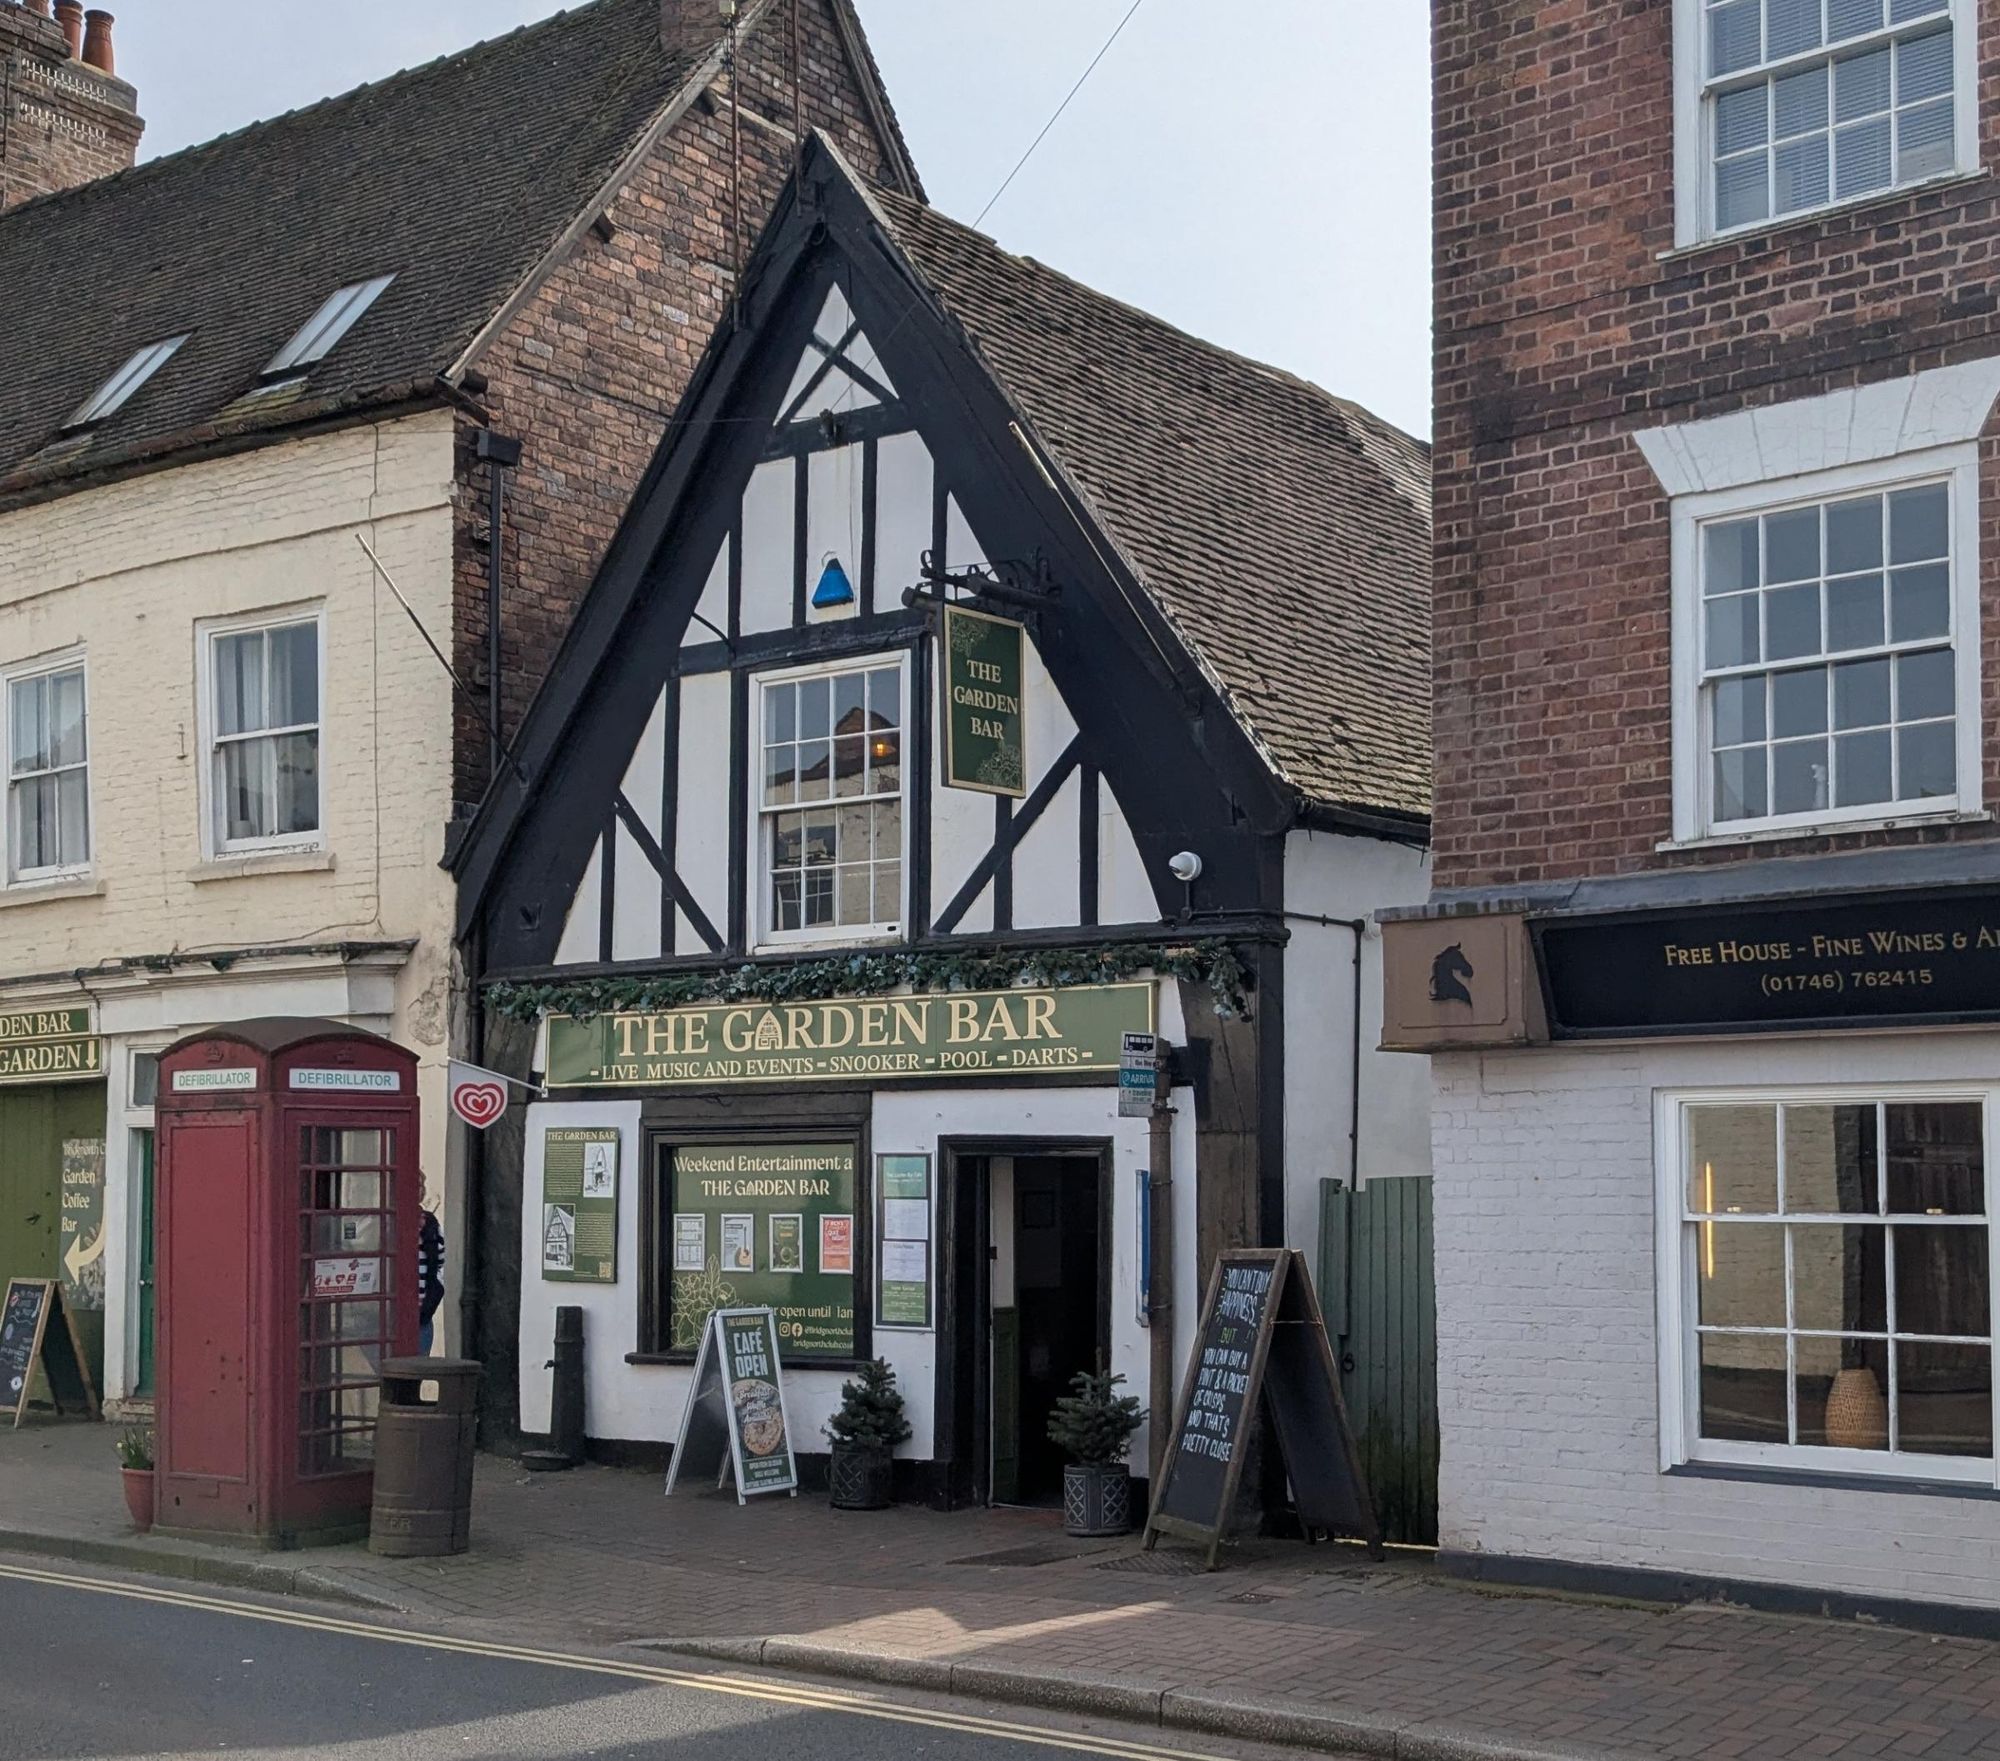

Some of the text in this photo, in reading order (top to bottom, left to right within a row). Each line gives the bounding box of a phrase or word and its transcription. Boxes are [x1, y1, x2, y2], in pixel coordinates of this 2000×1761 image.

[966, 659, 1001, 683] THE
[954, 685, 1018, 715] GARDEN
[970, 717, 1004, 740] BAR
[1952, 932, 1967, 948] &
[1761, 969, 1932, 996] (01746) 762415
[37, 1012, 71, 1034] BAR
[613, 994, 1062, 1057] THE GARDEN BAR
[0, 1044, 82, 1073] GARDEN
[602, 1064, 639, 1080] LIVE
[646, 1061, 700, 1079] MUSIC
[703, 1060, 741, 1077] AND
[746, 1057, 813, 1076] EVENTS
[829, 1053, 920, 1073] SNOOKER
[939, 1050, 993, 1069] POOL
[1012, 1047, 1078, 1066] DARTS
[178, 1072, 250, 1087] DEFIBRILLATOR
[298, 1072, 392, 1087] DEFIBRILLATOR
[547, 1131, 616, 1140] THE GARDEN BAR
[673, 1156, 734, 1172] Weekend
[738, 1155, 841, 1171] Entertainment
[62, 1168, 95, 1184] Garden
[701, 1179, 829, 1196] THE GARDEN BAR
[62, 1192, 90, 1208] Coffee
[61, 1216, 77, 1232] Bar
[780, 1307, 805, 1319] open
[808, 1306, 831, 1317] until
[733, 1326, 764, 1354] CAFÉ
[735, 1354, 768, 1378] OPEN
[1203, 1347, 1248, 1370] YOU CAN BUY A
[1198, 1368, 1249, 1394] PINT & A PACKET
[1193, 1389, 1226, 1412] OF CRISPS
[1186, 1409, 1230, 1438] AND THAT'S
[1181, 1433, 1232, 1462] PRETTY CLOSE
